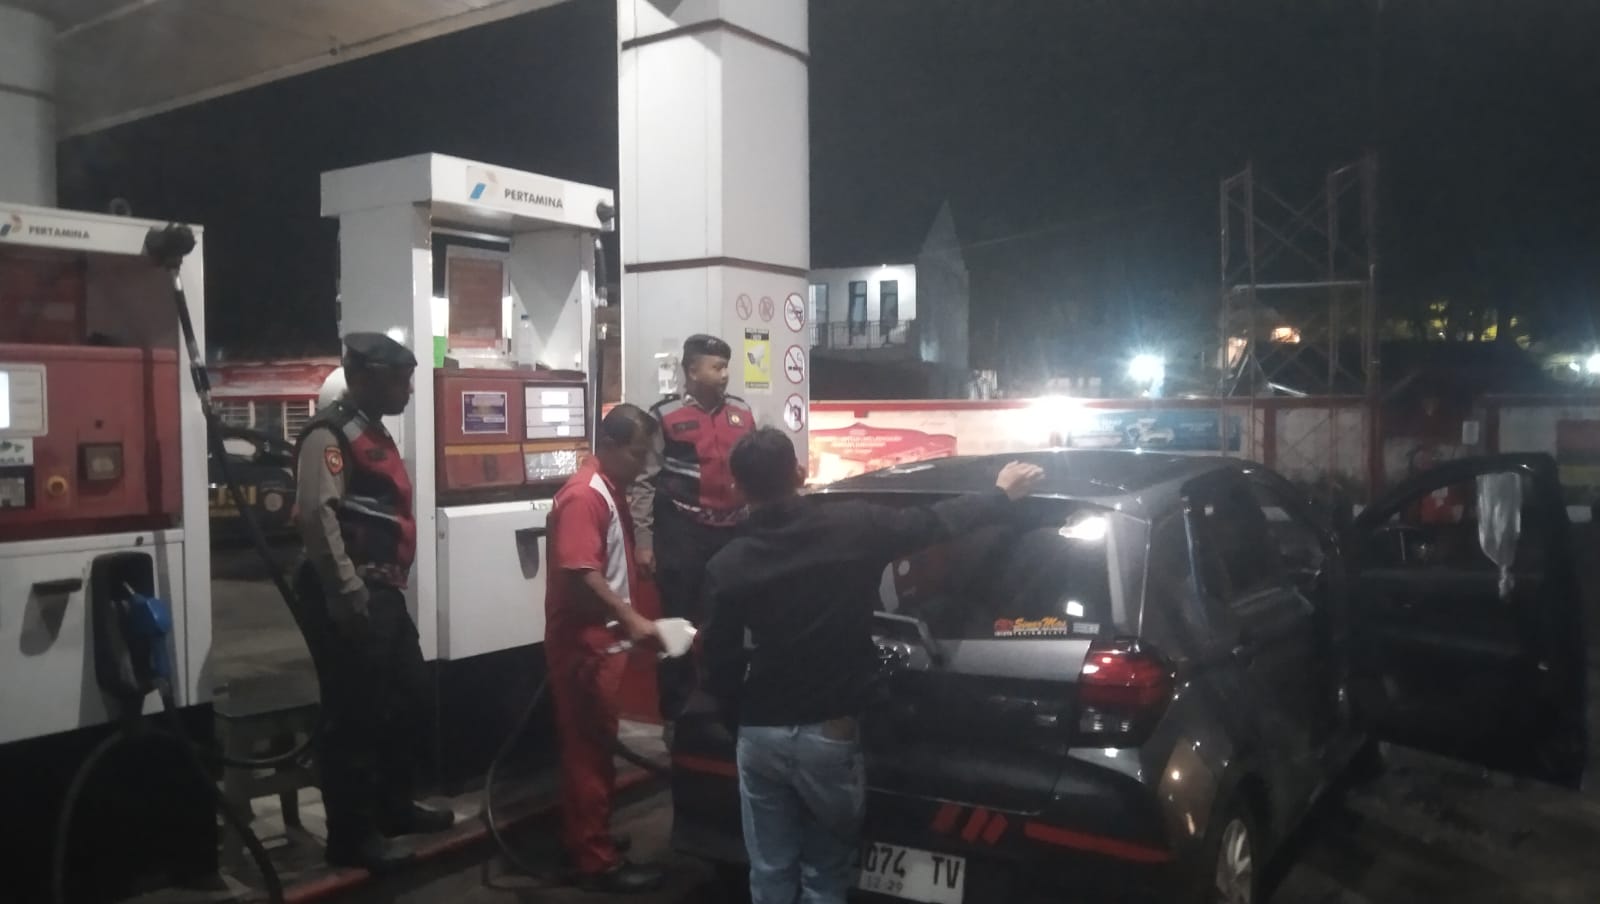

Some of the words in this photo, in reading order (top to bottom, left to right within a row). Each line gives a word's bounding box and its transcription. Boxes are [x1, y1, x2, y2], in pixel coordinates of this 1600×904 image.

[504, 188, 563, 209] PERTAMINA
[28, 224, 91, 239] PERTAMINA
[932, 856, 960, 889] TV
